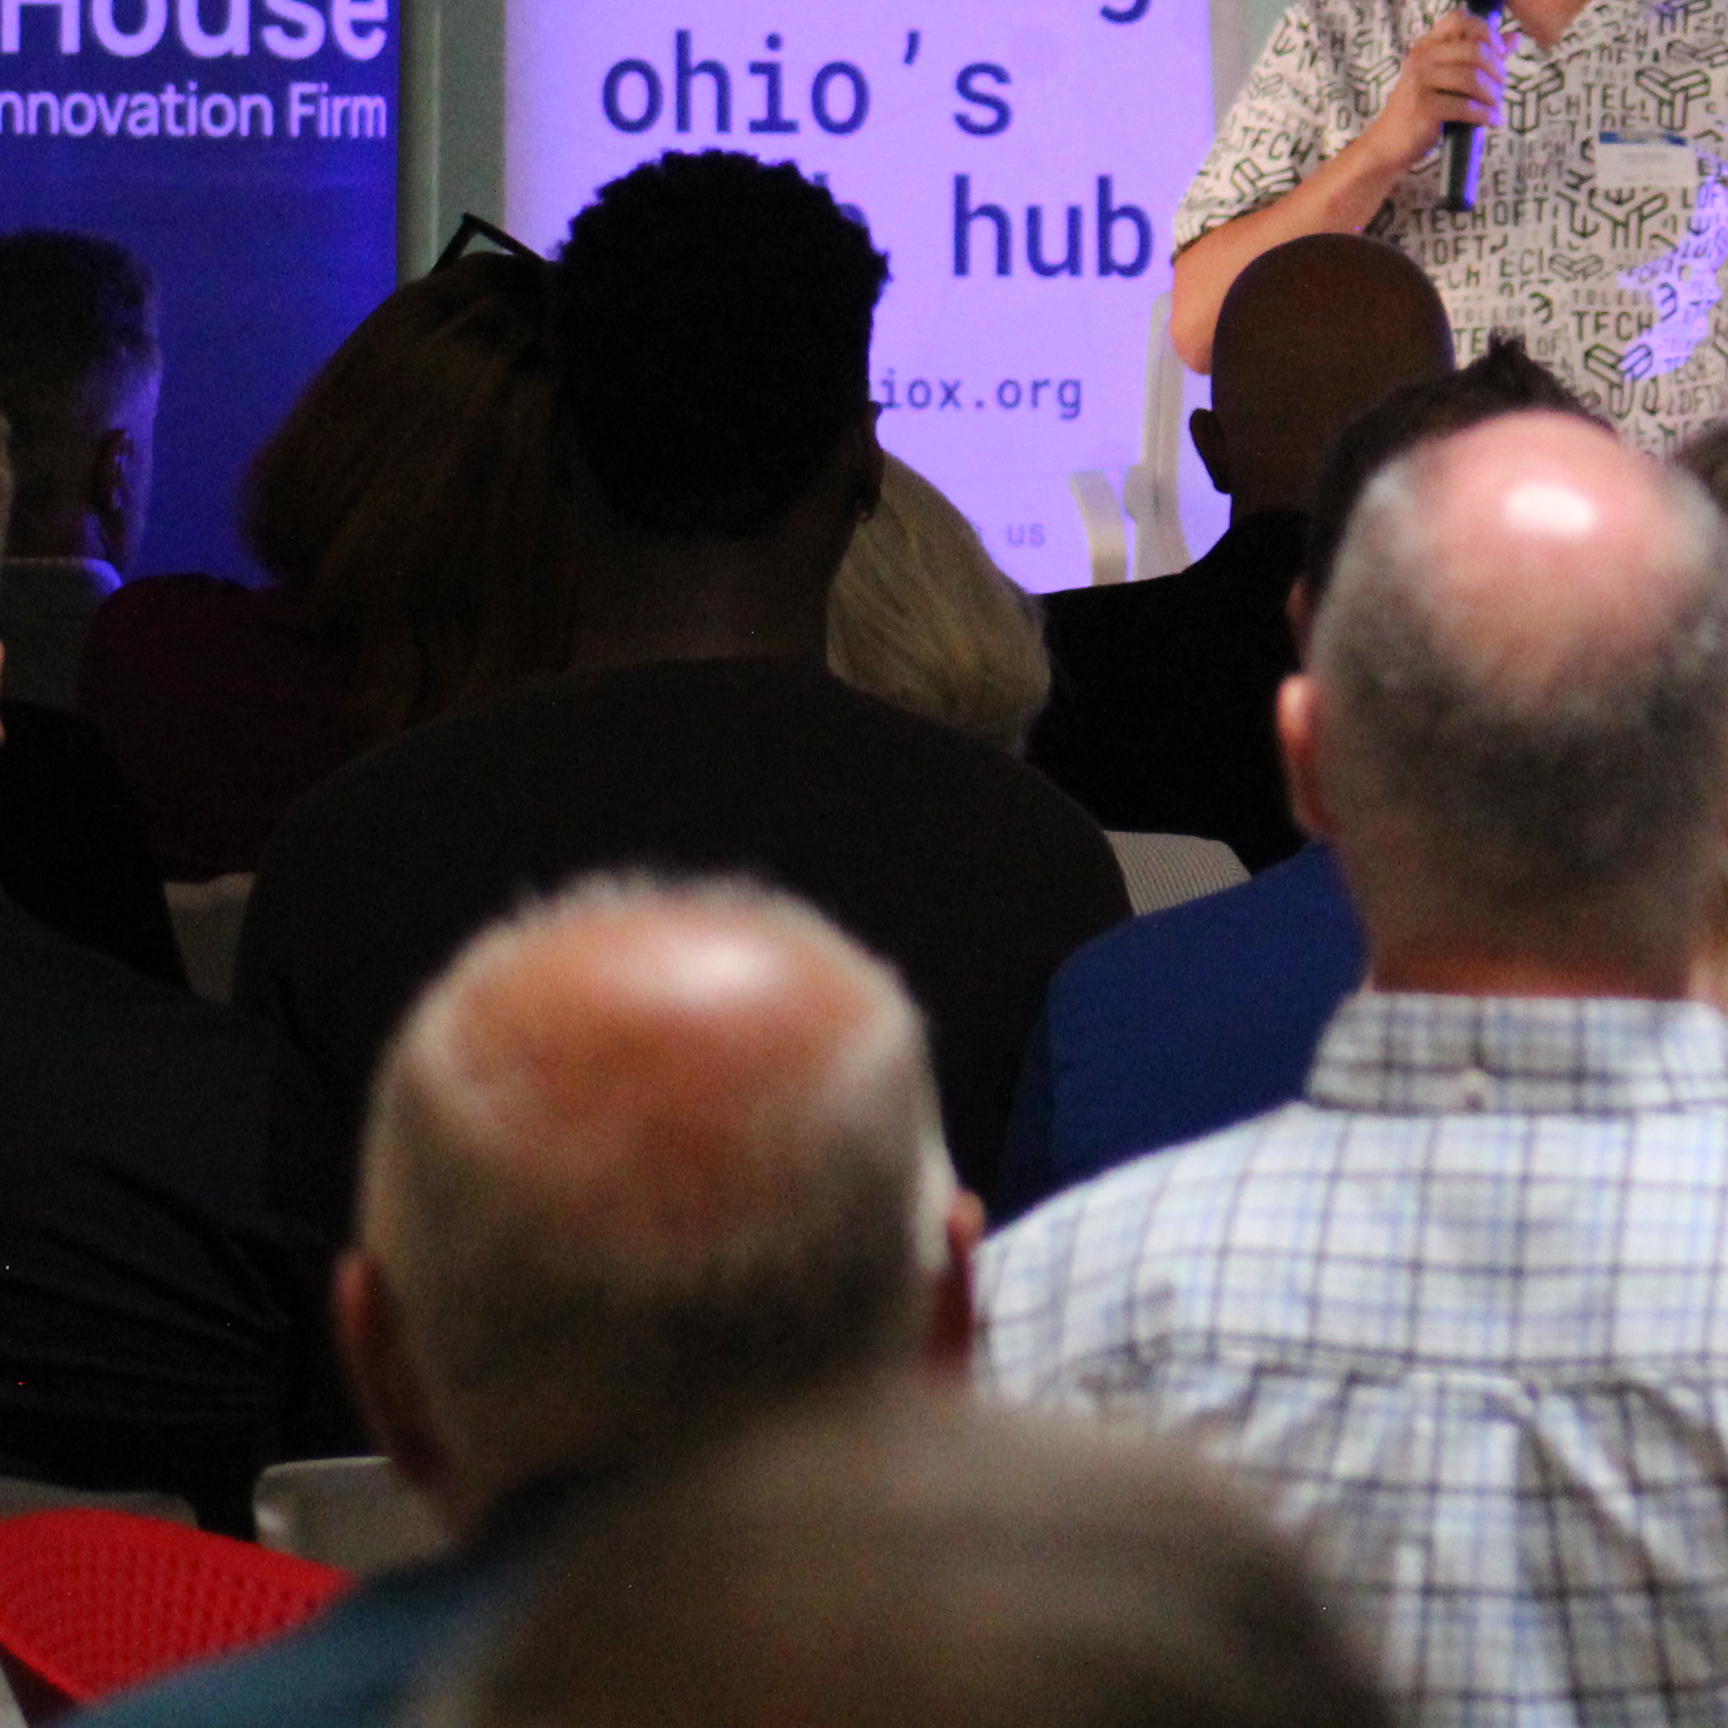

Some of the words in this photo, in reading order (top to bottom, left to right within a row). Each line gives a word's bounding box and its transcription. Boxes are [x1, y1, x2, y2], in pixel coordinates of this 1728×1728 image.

[287, 80, 388, 139] Firm
[602, 28, 1013, 136] ohio's
[952, 173, 1154, 278] hub
